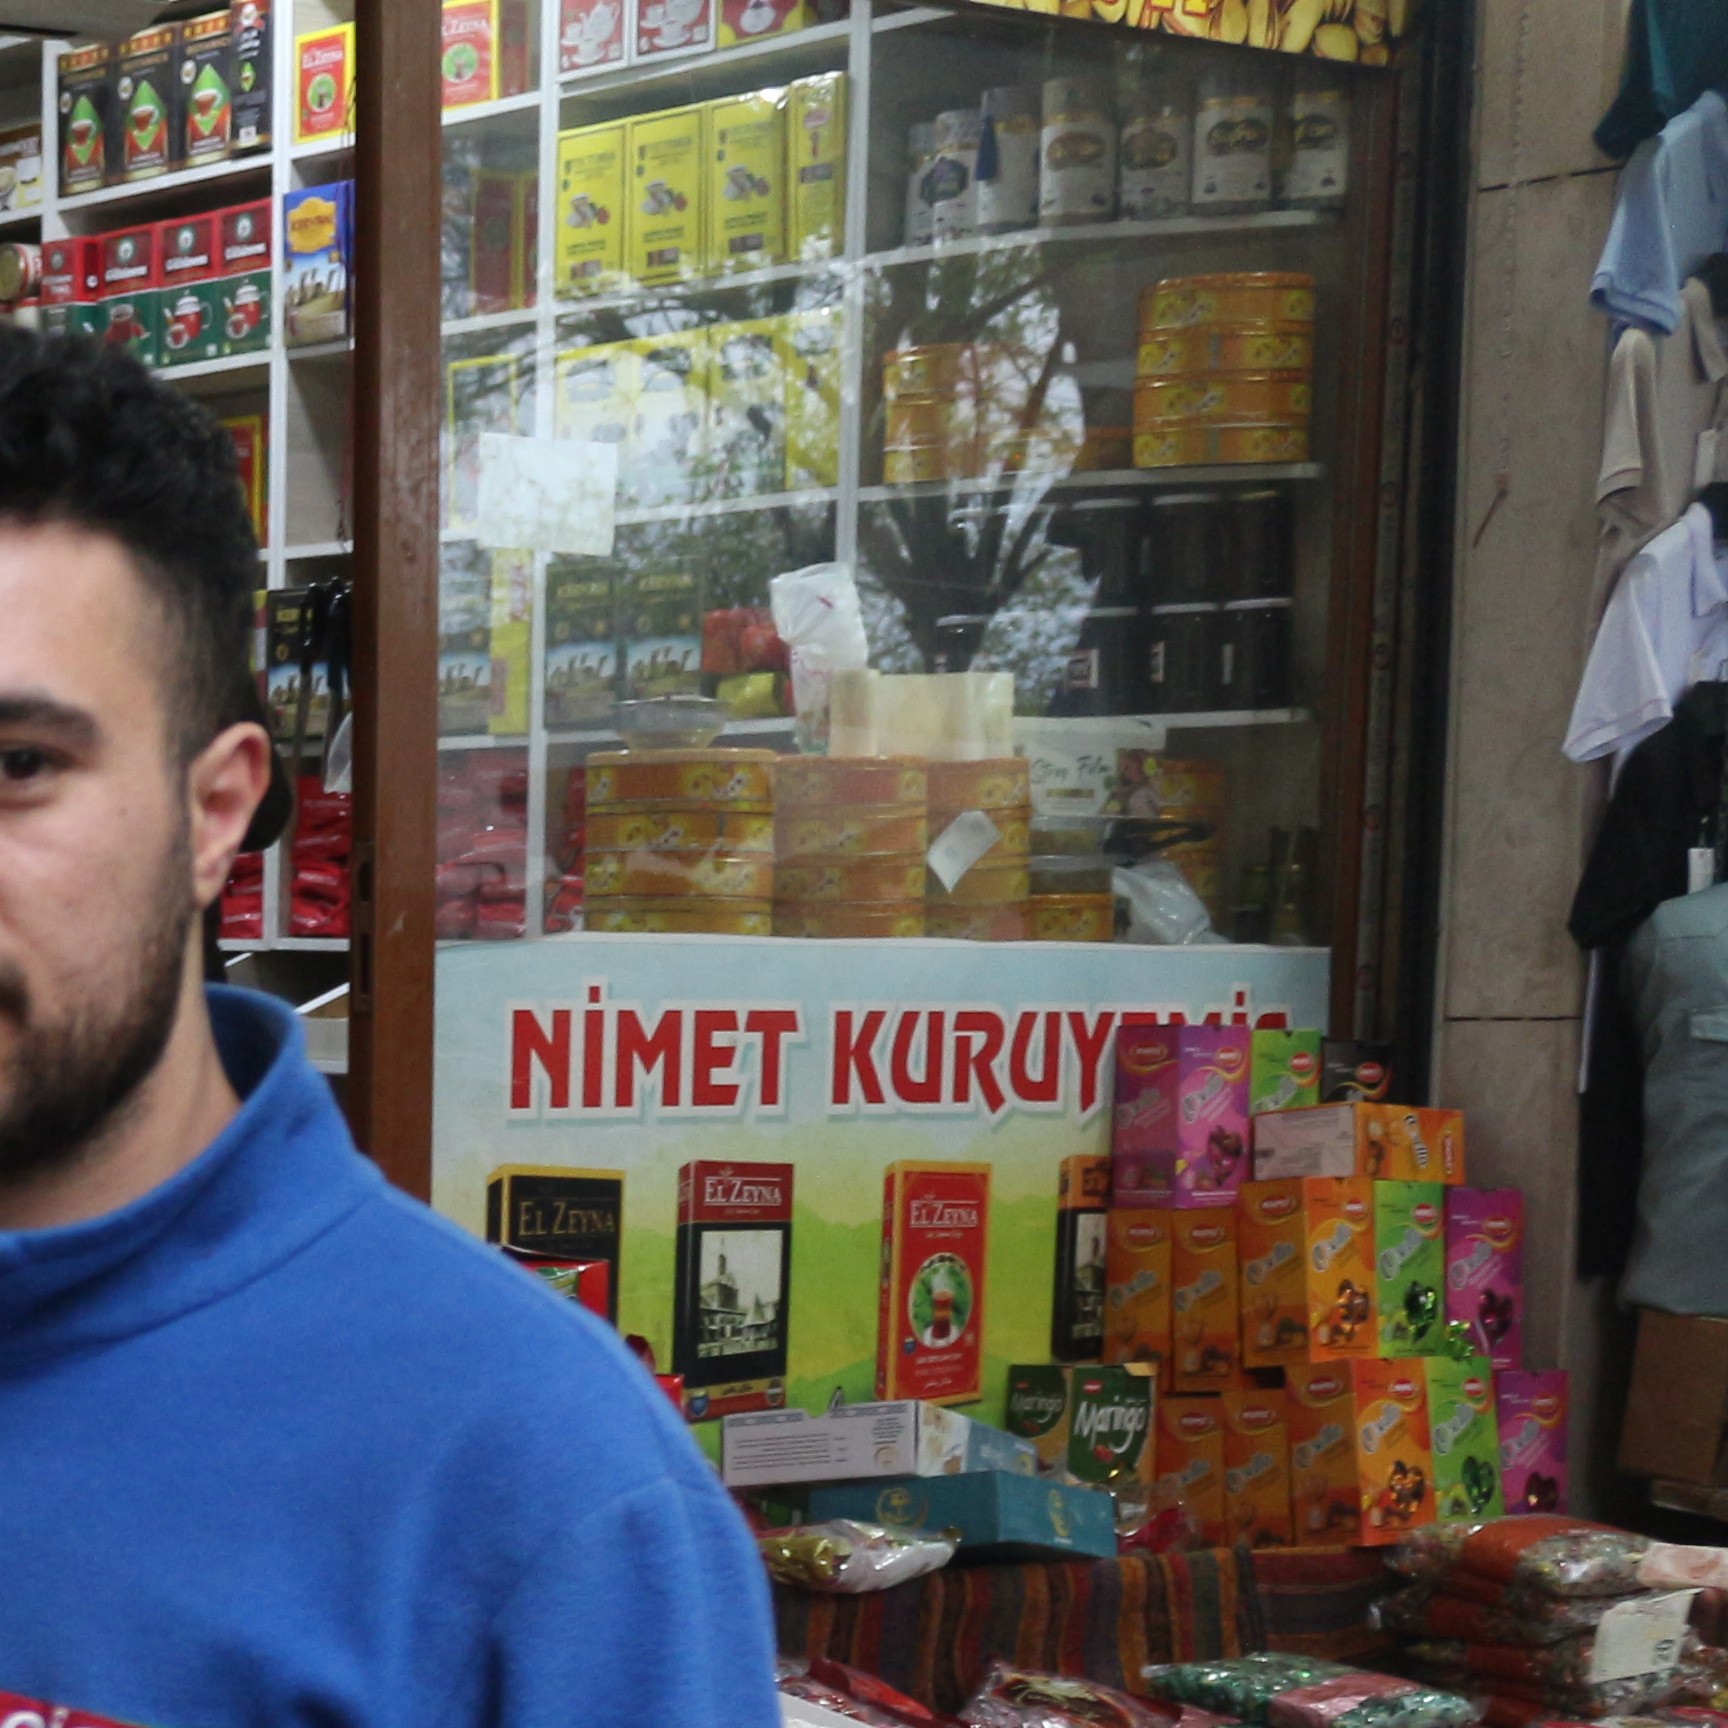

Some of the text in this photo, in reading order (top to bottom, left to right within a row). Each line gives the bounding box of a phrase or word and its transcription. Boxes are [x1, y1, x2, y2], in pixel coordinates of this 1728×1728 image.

[509, 984, 799, 1109] NİMET
[830, 988, 1290, 1113] KURUY
[704, 1177, 783, 1206] EL ZEYNA
[518, 1201, 617, 1238] EL ZEYNA
[909, 1201, 980, 1228] EL ZEYNA
